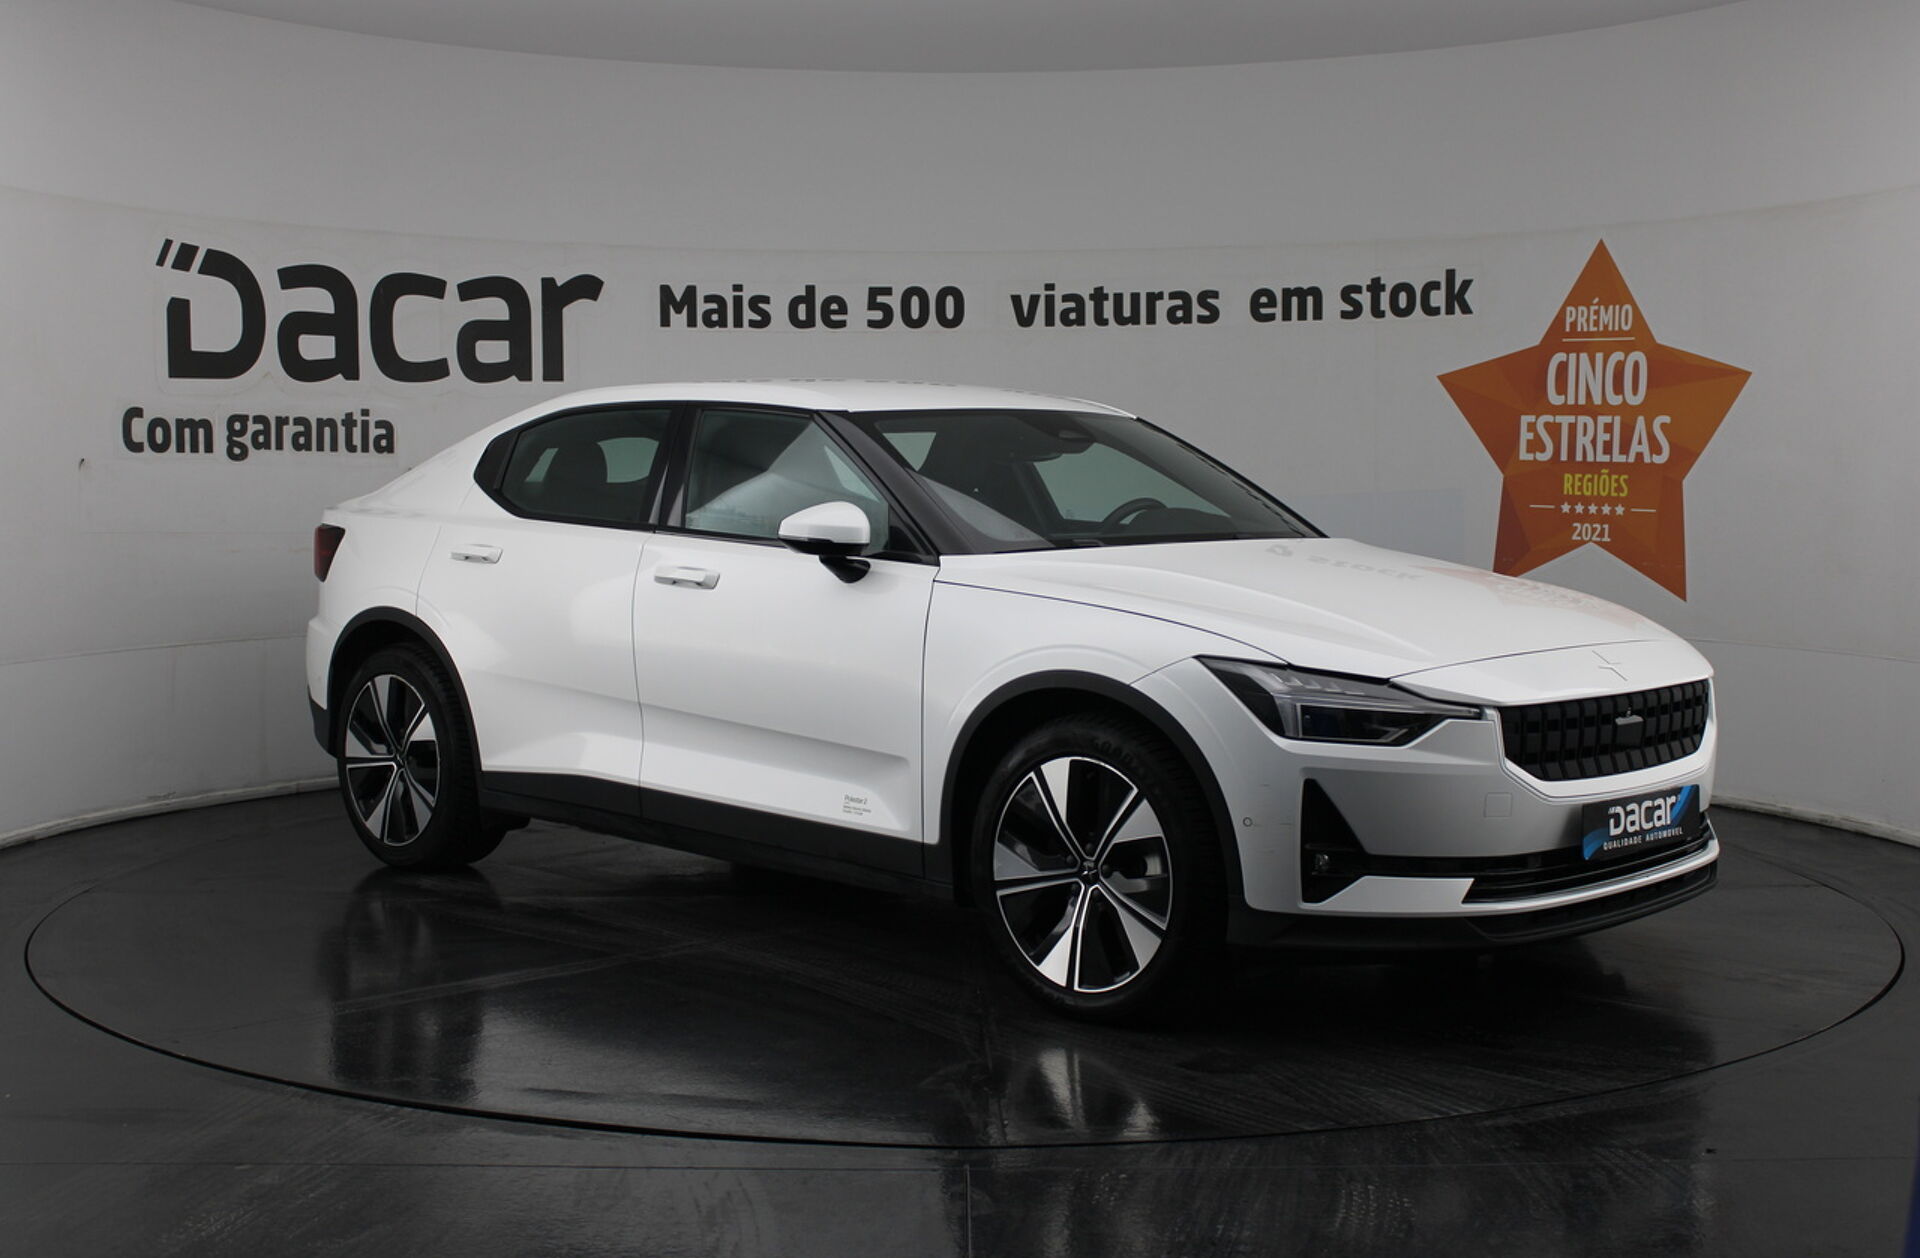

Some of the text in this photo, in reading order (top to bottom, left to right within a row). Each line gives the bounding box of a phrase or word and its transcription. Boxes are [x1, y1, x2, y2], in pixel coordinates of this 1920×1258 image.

[155, 238, 605, 383] Dacar
[658, 268, 1475, 329] Mais de 500 viaturas em stock
[1564, 297, 1633, 332] PRÉMIO
[1546, 350, 1648, 406] CINCO
[121, 406, 396, 462] Com garantia
[1518, 414, 1671, 464] ESTRELAS
[1563, 468, 1629, 497] REGIÕES
[1571, 522, 1611, 542] 2021
[1608, 795, 1677, 836] Dacar
[1603, 834, 1642, 851] QUALIDADE
